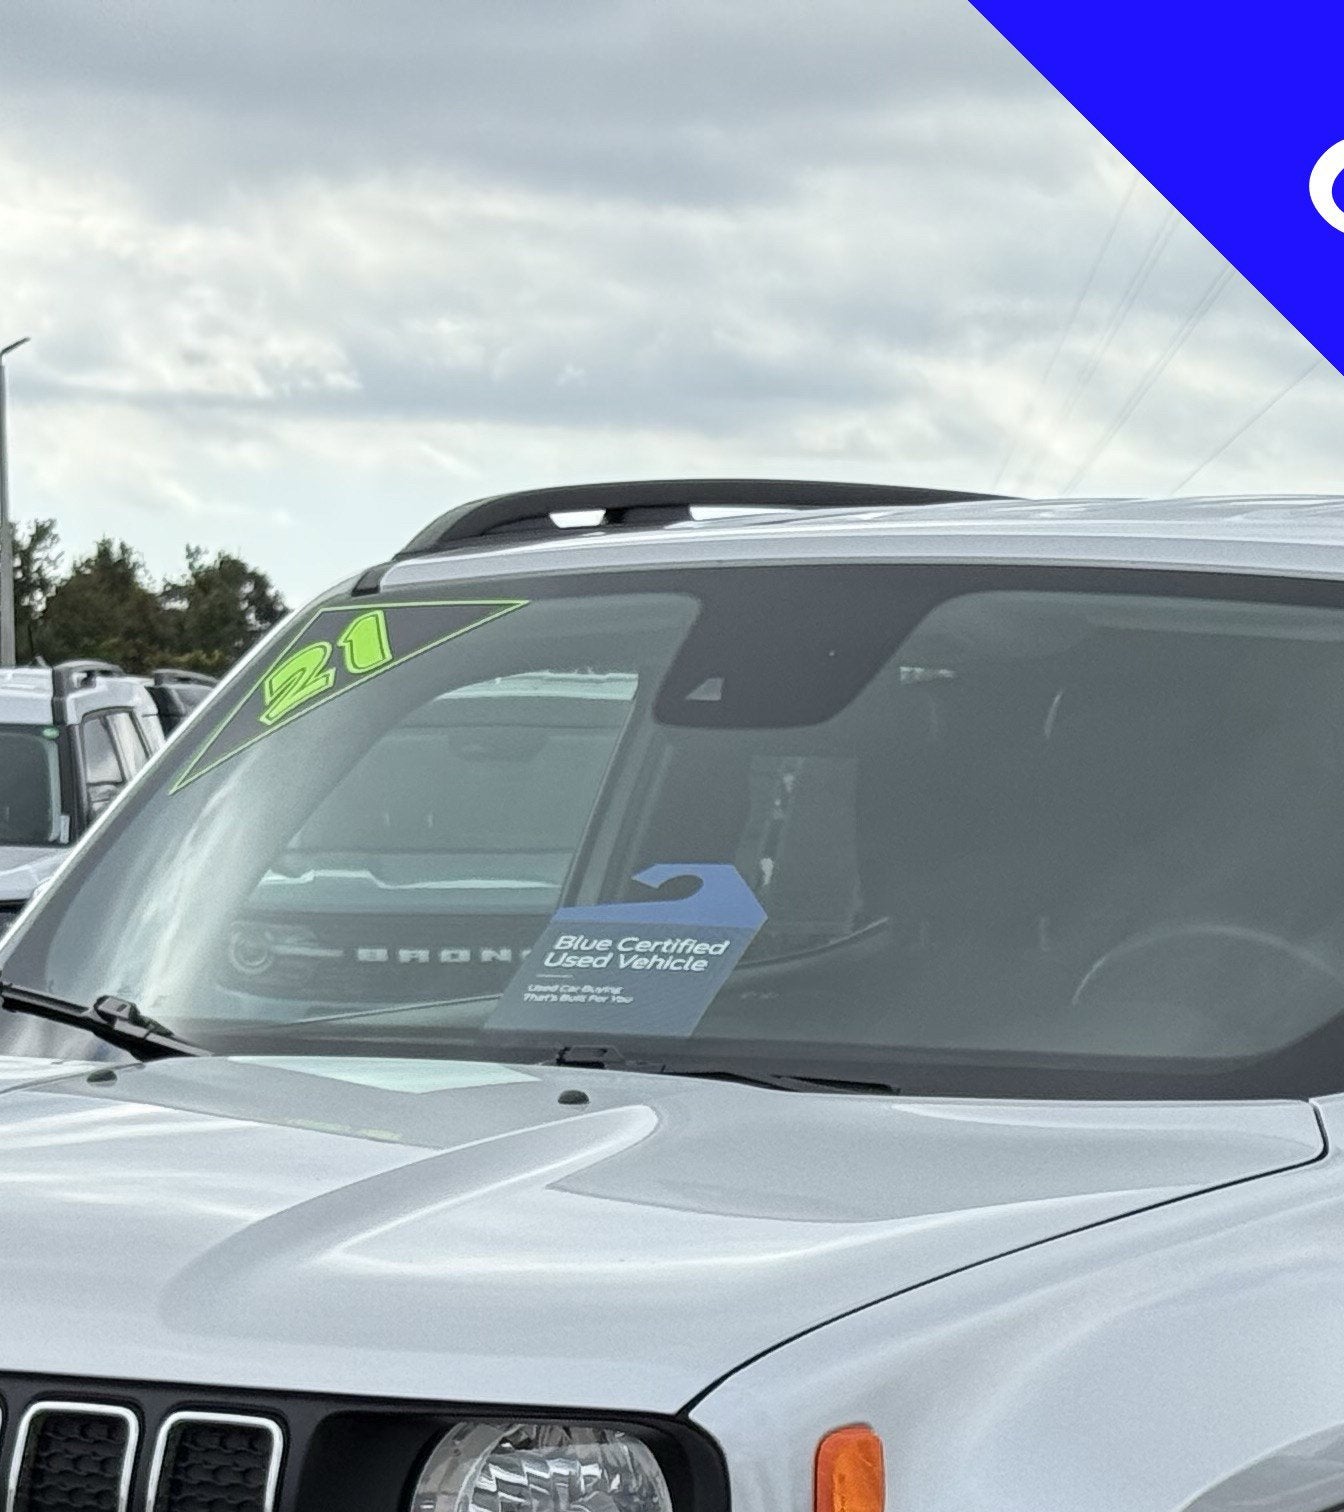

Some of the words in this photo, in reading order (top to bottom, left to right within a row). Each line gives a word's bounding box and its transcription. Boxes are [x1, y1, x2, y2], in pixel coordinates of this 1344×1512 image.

[259, 609, 394, 726] 21
[357, 948, 532, 963] BRON
[554, 934, 613, 951] Blue
[616, 936, 731, 956] Certified
[543, 951, 614, 969] Used
[618, 953, 709, 972] Vehicle
